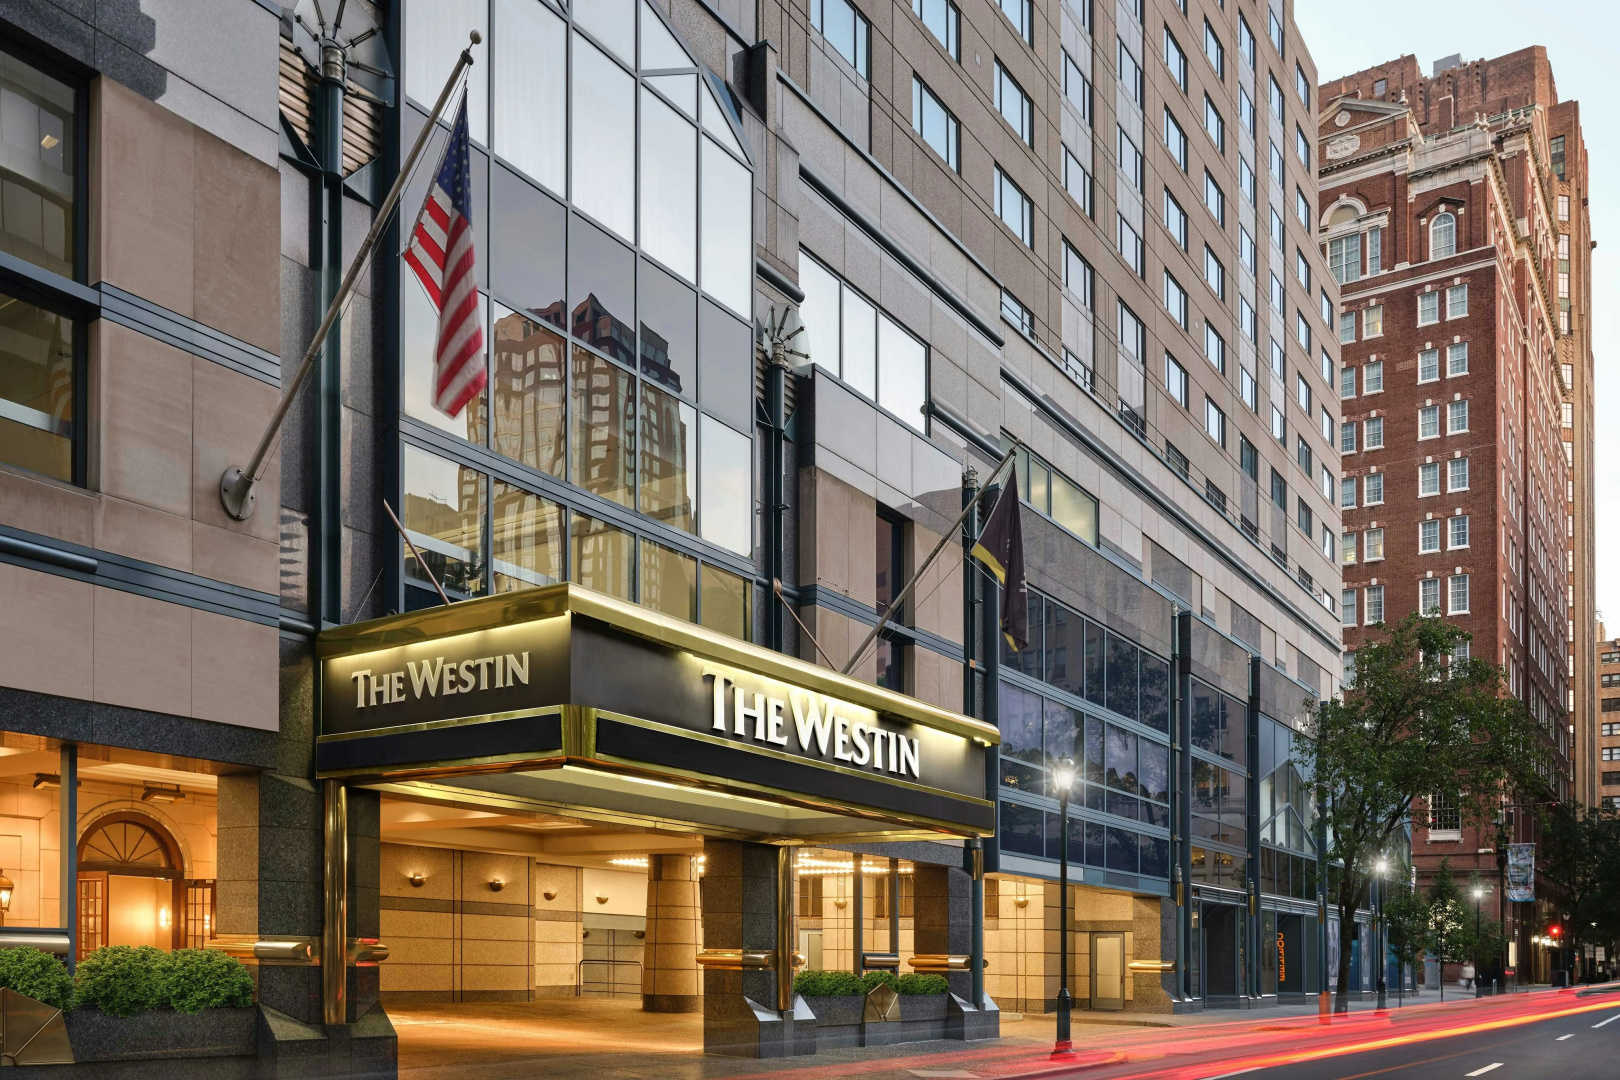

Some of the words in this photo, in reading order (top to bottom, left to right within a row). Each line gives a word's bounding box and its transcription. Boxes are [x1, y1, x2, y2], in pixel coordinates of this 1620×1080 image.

[351, 669, 406, 708] THE
[406, 652, 530, 700] WESTIN
[702, 666, 788, 747] THE
[787, 690, 920, 779] WESTIN
